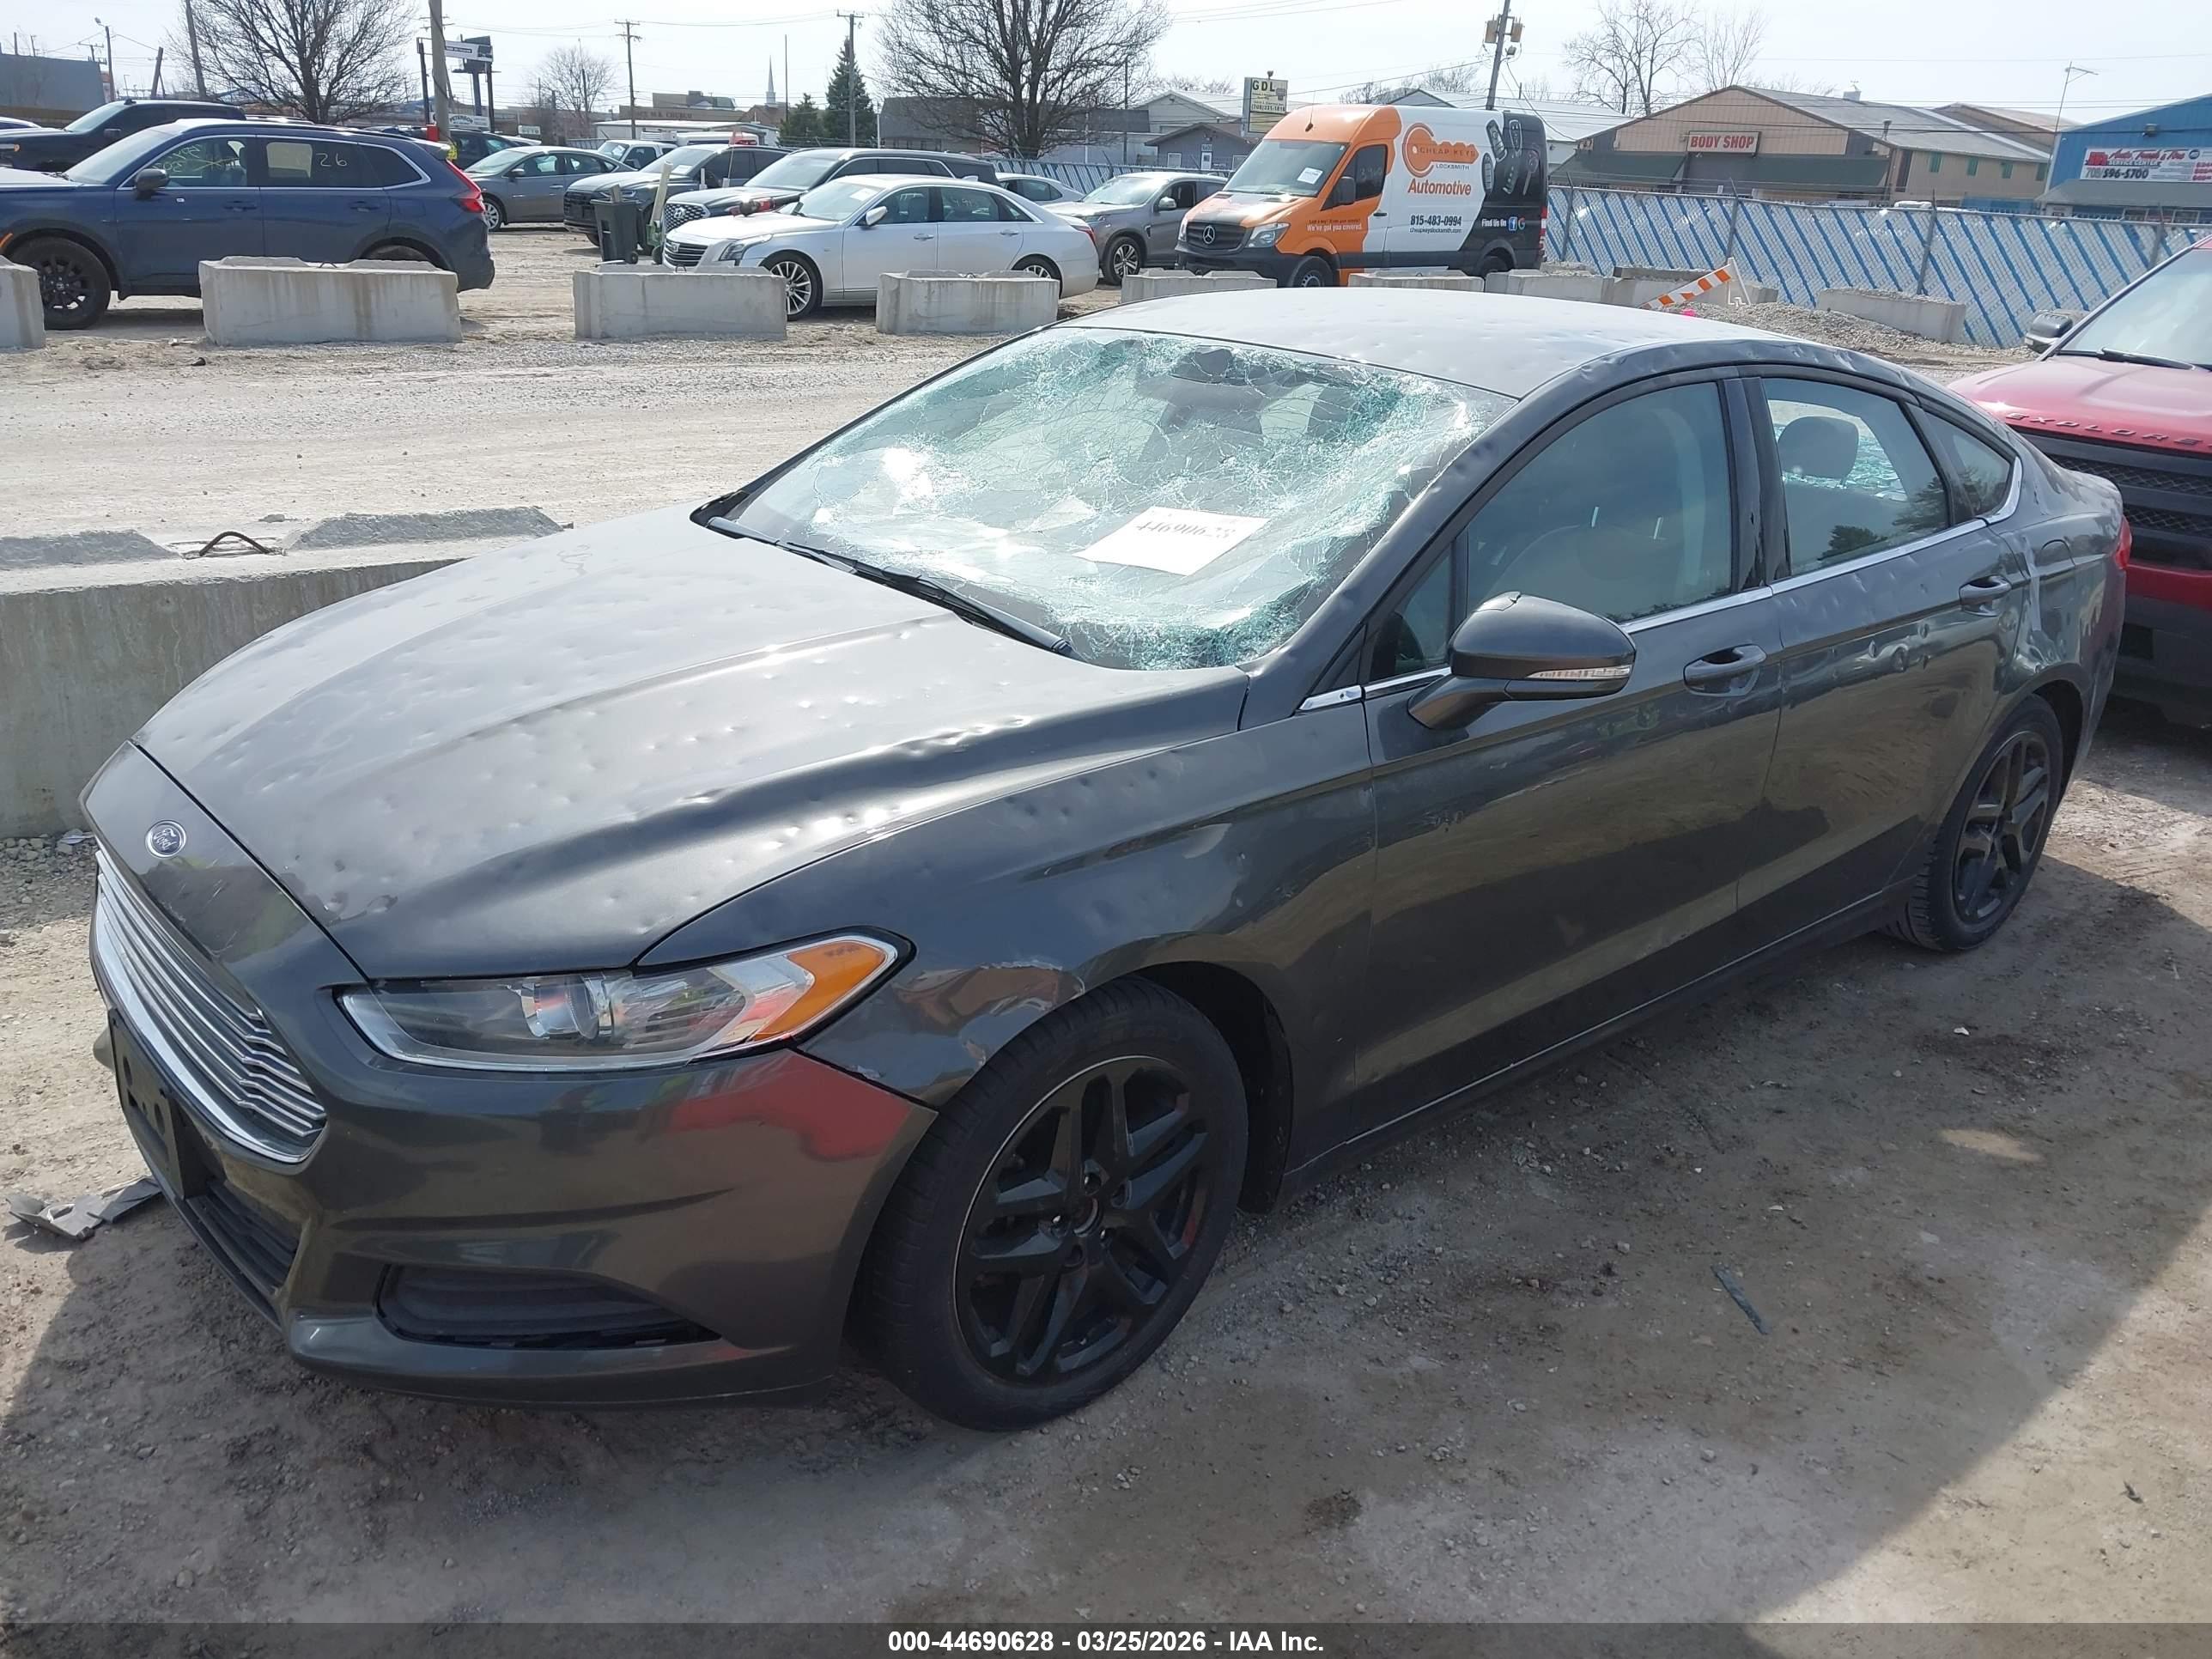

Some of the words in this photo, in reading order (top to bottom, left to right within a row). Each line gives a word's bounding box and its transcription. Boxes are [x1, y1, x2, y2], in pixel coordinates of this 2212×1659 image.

[1252, 80, 1275, 92] GDL
[1690, 136, 1721, 148] BODY
[1723, 136, 1754, 149] SHOP
[1407, 178, 1472, 196] Automotive
[1410, 215, 1462, 226] 815-483-0994
[1481, 218, 1492, 228] Find
[1493, 219, 1499, 228] Us
[1499, 219, 1507, 228] On
[2006, 412, 2212, 448] EXPLORE
